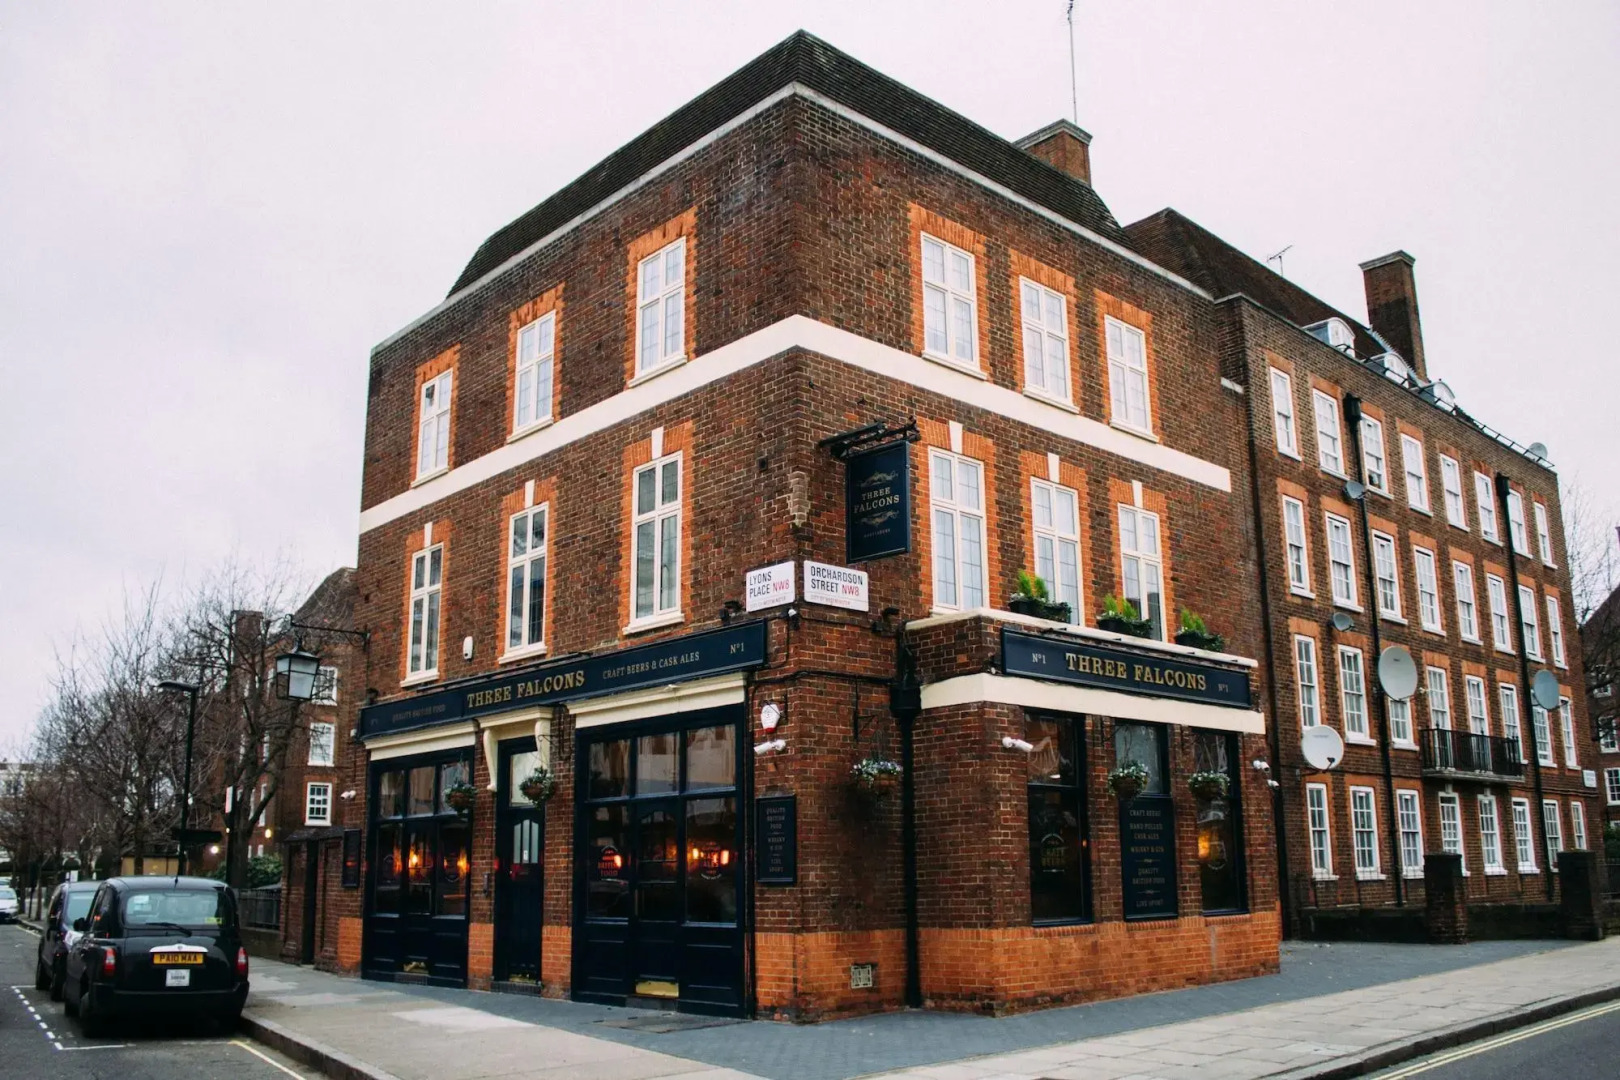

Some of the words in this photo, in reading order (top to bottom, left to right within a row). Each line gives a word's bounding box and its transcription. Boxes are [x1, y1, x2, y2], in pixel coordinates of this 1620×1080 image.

[853, 494, 900, 514] FALCONS
[861, 487, 891, 501] THREE
[749, 571, 772, 586] LYONS
[810, 565, 863, 585] ORCHARDSON
[749, 583, 770, 598] PLACE
[772, 579, 790, 592] NW8
[810, 579, 839, 593] STREET
[841, 584, 860, 597] NW8
[602, 666, 626, 679] CRAFT
[626, 661, 650, 675] BEERS
[651, 660, 657, 670] &
[658, 656, 679, 670] CASK
[680, 651, 700, 664] ALES
[1065, 652, 1128, 679] THREE
[1133, 663, 1207, 691] FALCONS
[466, 685, 512, 708] THREE
[516, 670, 585, 699] FALCONS
